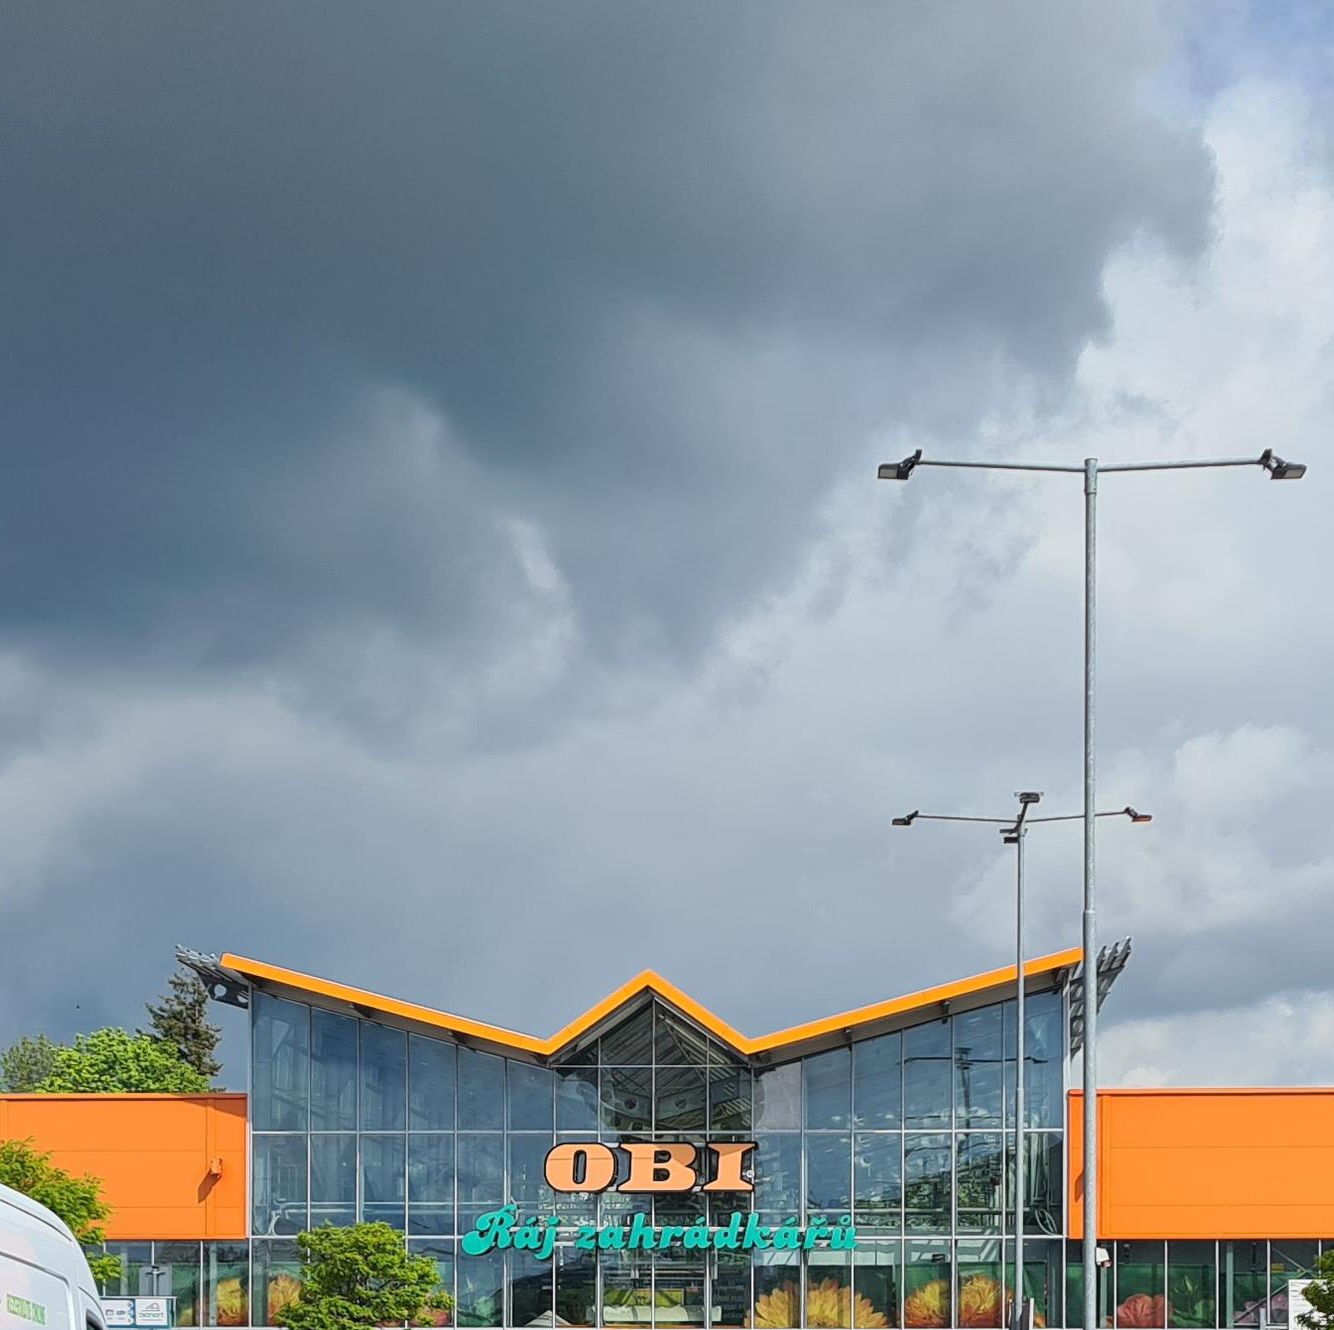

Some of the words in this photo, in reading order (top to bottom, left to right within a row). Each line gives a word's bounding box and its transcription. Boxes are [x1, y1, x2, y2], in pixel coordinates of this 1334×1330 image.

[543, 1141, 759, 1194] OBI
[461, 1203, 561, 1261] Ráj
[576, 1211, 860, 1251] zahrádkářů
